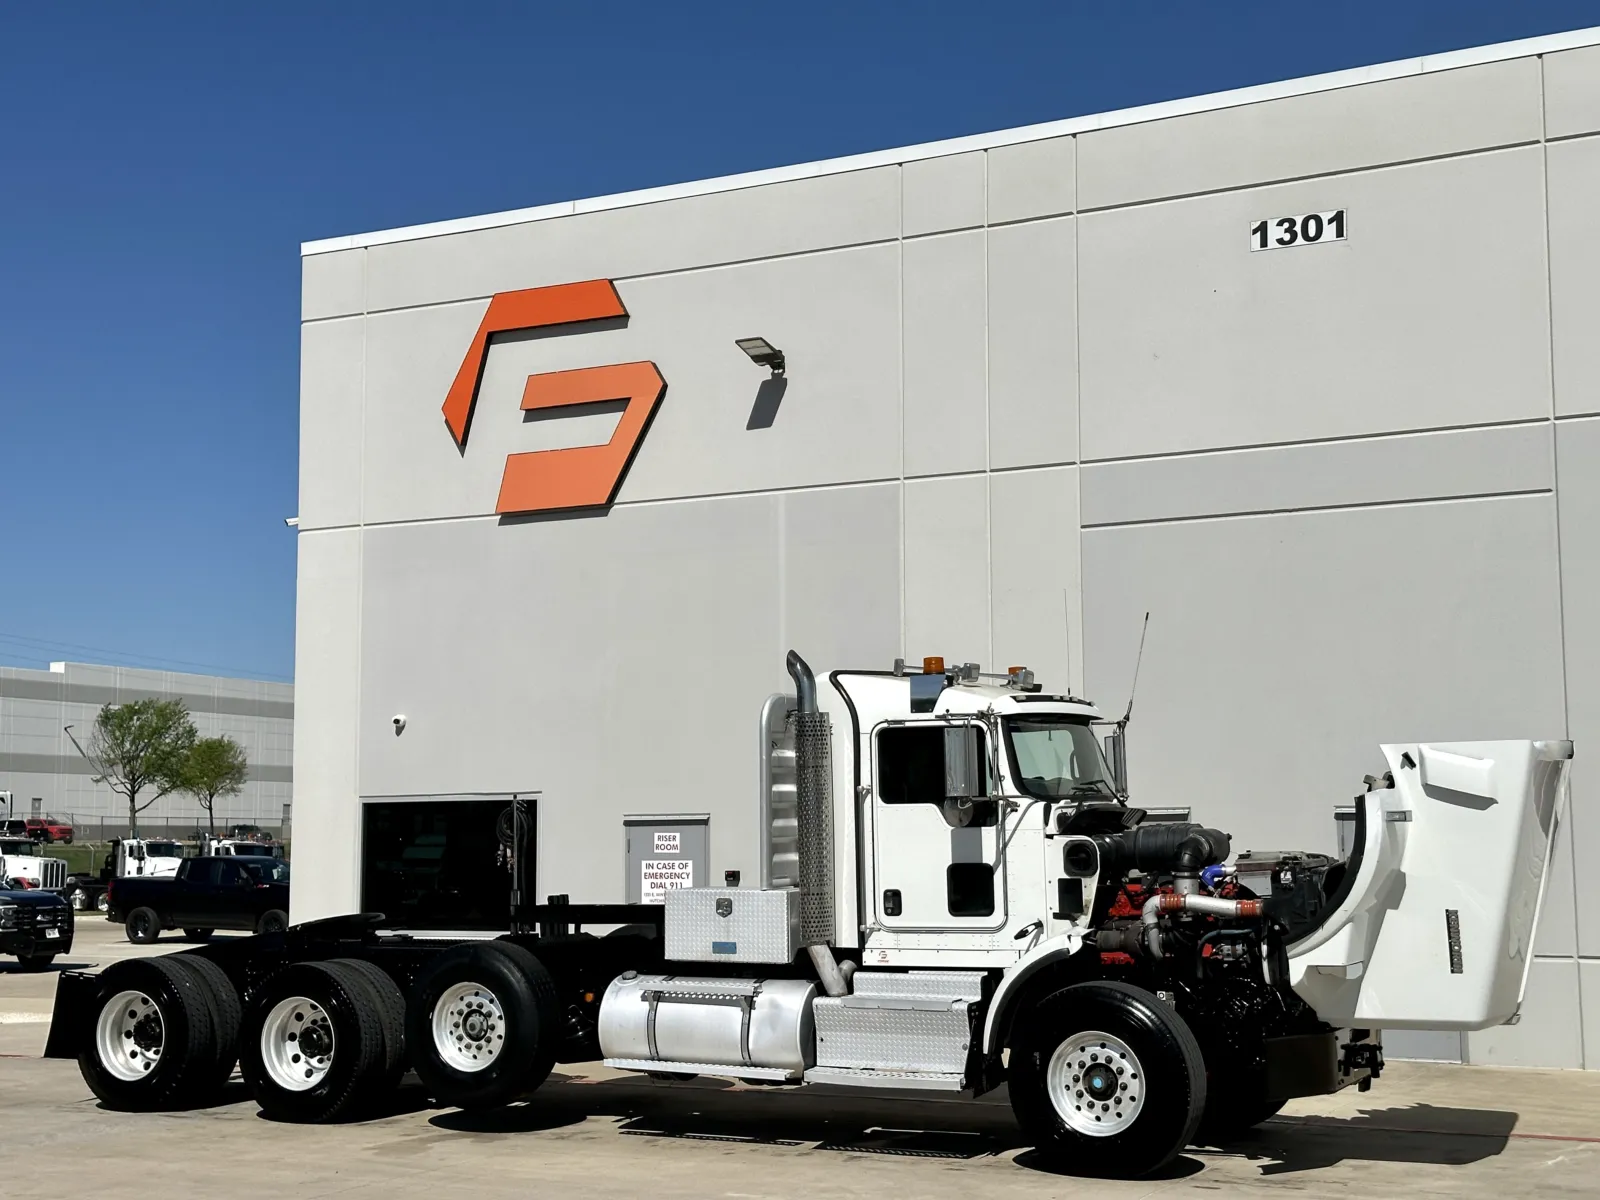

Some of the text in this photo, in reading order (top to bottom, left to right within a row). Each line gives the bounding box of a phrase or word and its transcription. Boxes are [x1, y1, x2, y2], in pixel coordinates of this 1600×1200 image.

[1251, 209, 1345, 249] 1301
[657, 834, 677, 842] RISER
[655, 843, 679, 851] ROOM
[645, 862, 689, 870] IN CASE OF
[643, 872, 691, 880] EMERGENCY
[650, 881, 683, 889] DIAL 911
[1447, 909, 1463, 974] KENWORTH
